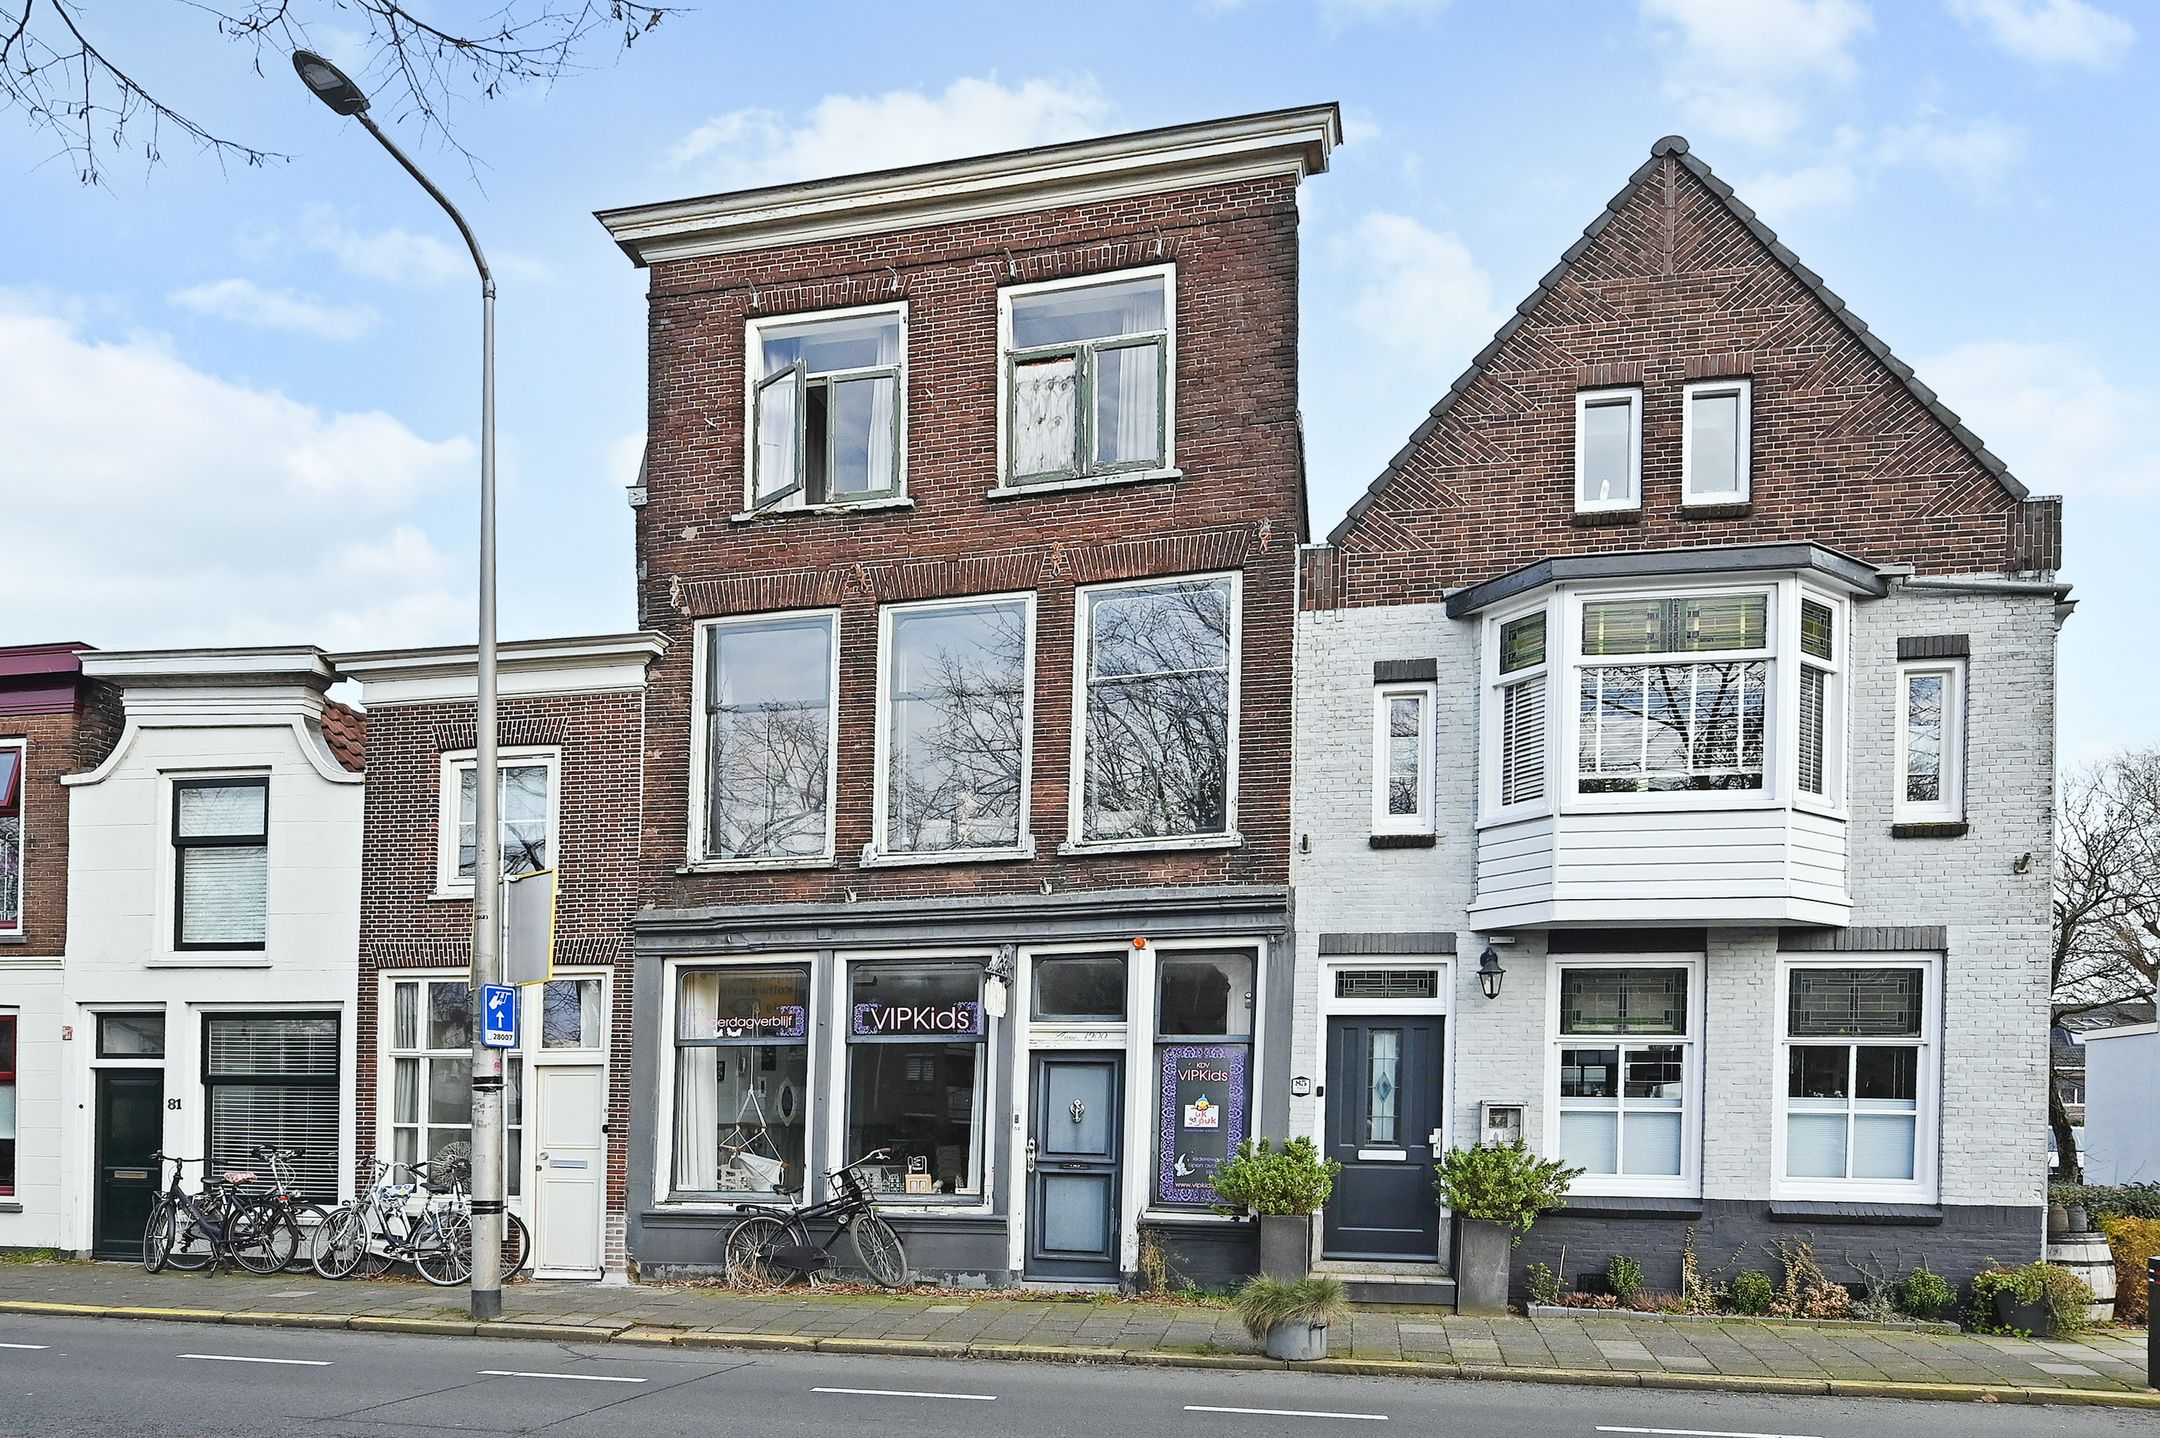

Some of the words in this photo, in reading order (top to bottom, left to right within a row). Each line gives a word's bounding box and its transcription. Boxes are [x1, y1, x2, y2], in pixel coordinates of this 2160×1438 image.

[704, 1015, 793, 1030] derdagverblijf
[870, 1006, 970, 1031] VIPKids
[493, 1033, 513, 1041] 28007
[1178, 1069, 1228, 1082] VIPKids
[167, 1098, 182, 1110] 81
